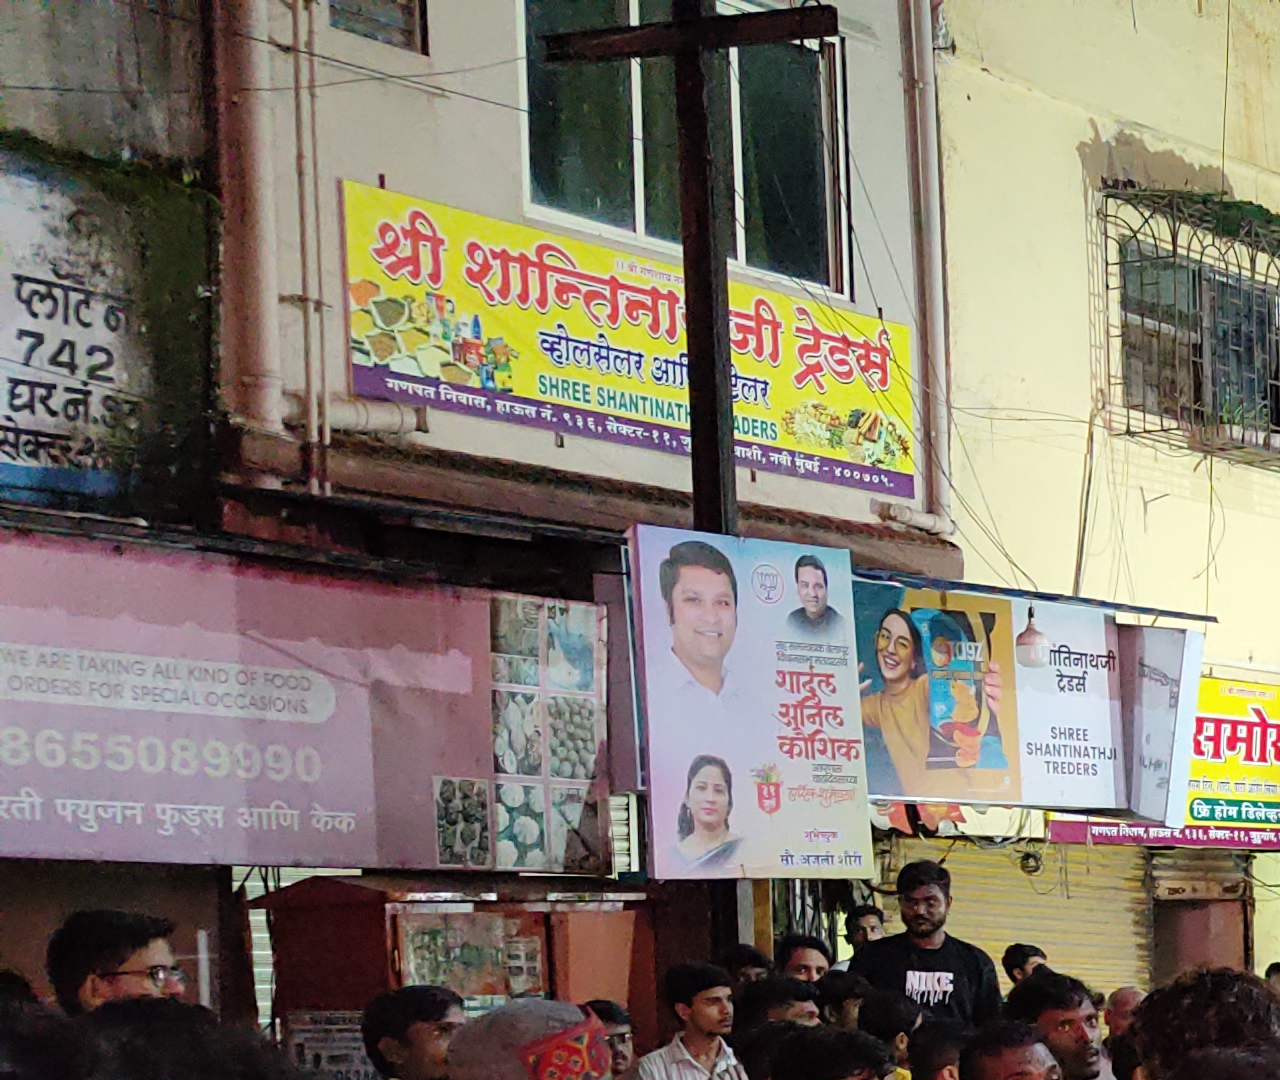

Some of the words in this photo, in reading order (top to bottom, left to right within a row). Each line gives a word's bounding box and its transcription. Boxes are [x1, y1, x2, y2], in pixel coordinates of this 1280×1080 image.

[369, 209, 447, 289] श्री
[464, 241, 784, 367] शान्तिनाजी
[792, 306, 892, 394] ट्रेडर्स
[15, 328, 116, 384] 742
[537, 322, 645, 382] व्होलसेलर
[7, 376, 59, 419] घर
[384, 376, 436, 400] गणपत
[438, 380, 493, 413] निवास,
[495, 398, 537, 420] हाऊस
[537, 375, 592, 406] SHREE
[768, 450, 793, 469] नवी
[794, 452, 821, 476] मुंबई
[35, 652, 72, 673] ARE
[76, 654, 147, 679] TAKING
[151, 662, 182, 682] ALL
[186, 665, 230, 686] KIND
[235, 669, 258, 688] OF
[263, 671, 314, 694] FOOD
[1056, 669, 1088, 693] ट्रेडर्स
[7, 673, 84, 699] ORDERS
[87, 680, 125, 702] FOR
[131, 684, 202, 709] SPECIAL
[203, 690, 310, 718] OCCASIONS
[1050, 726, 1090, 742] SHREE
[1026, 741, 1118, 762] SHANTINATHJI
[1044, 760, 1099, 777] TREDERS
[236, 798, 301, 833] आणि
[308, 800, 357, 835] केक
[1213, 800, 1239, 821] होम
[906, 970, 953, 1001] NIKE
